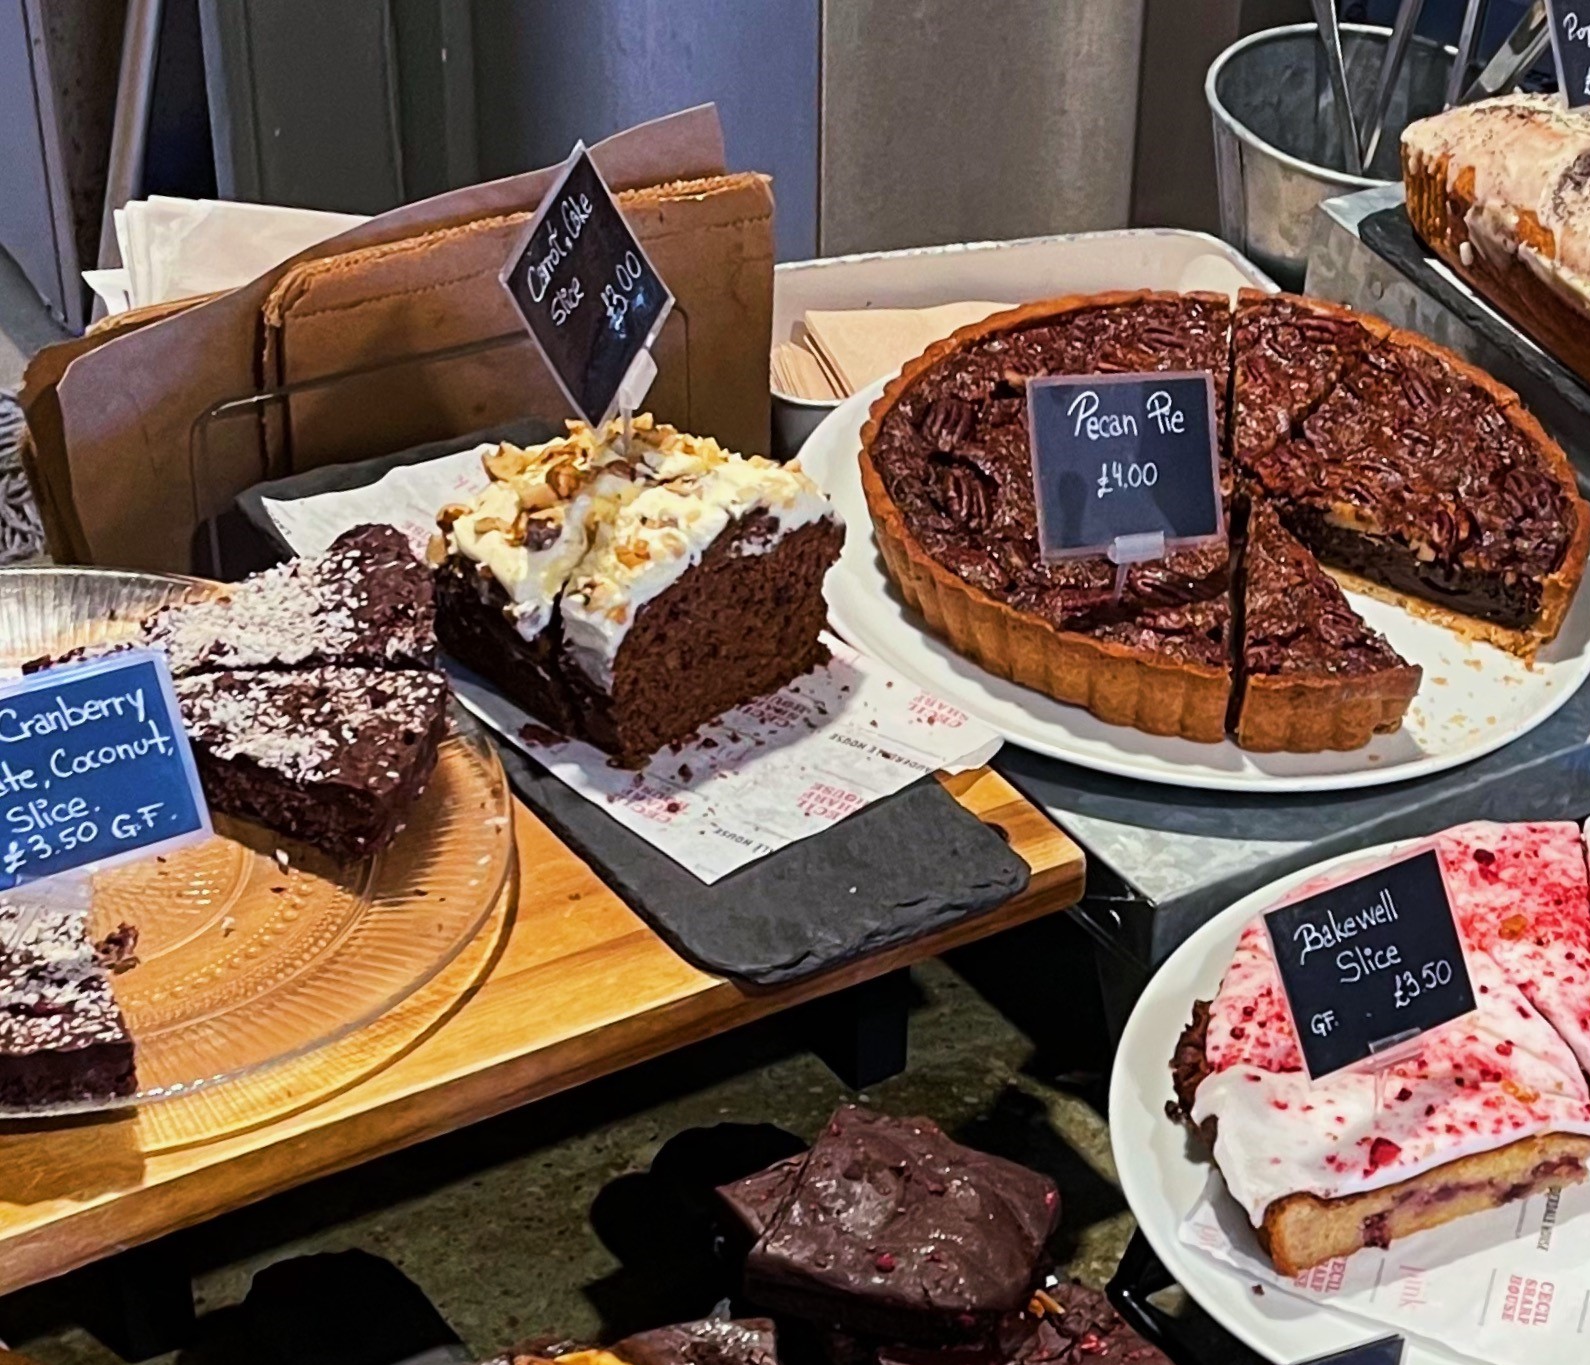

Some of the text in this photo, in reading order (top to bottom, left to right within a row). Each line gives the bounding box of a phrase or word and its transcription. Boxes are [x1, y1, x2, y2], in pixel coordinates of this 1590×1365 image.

[561, 193, 593, 239] Cake
[551, 277, 585, 327] Slice
[1067, 390, 1185, 441] Pecan Pie
[1097, 462, 1158, 498] £4.00
[0, 688, 146, 743] Cranberry
[795, 797, 840, 821] ECIL
[4, 820, 99, 875] £3.50
[1292, 888, 1399, 966] Bakewell
[1335, 945, 1402, 983] Slice
[1393, 959, 1452, 1009] £3.50
[1324, 1256, 1347, 1292] ECIL
[1501, 1274, 1523, 1322] HOUSE
[1517, 1277, 1538, 1325] SHARP
[1532, 1280, 1555, 1327] CECIL
